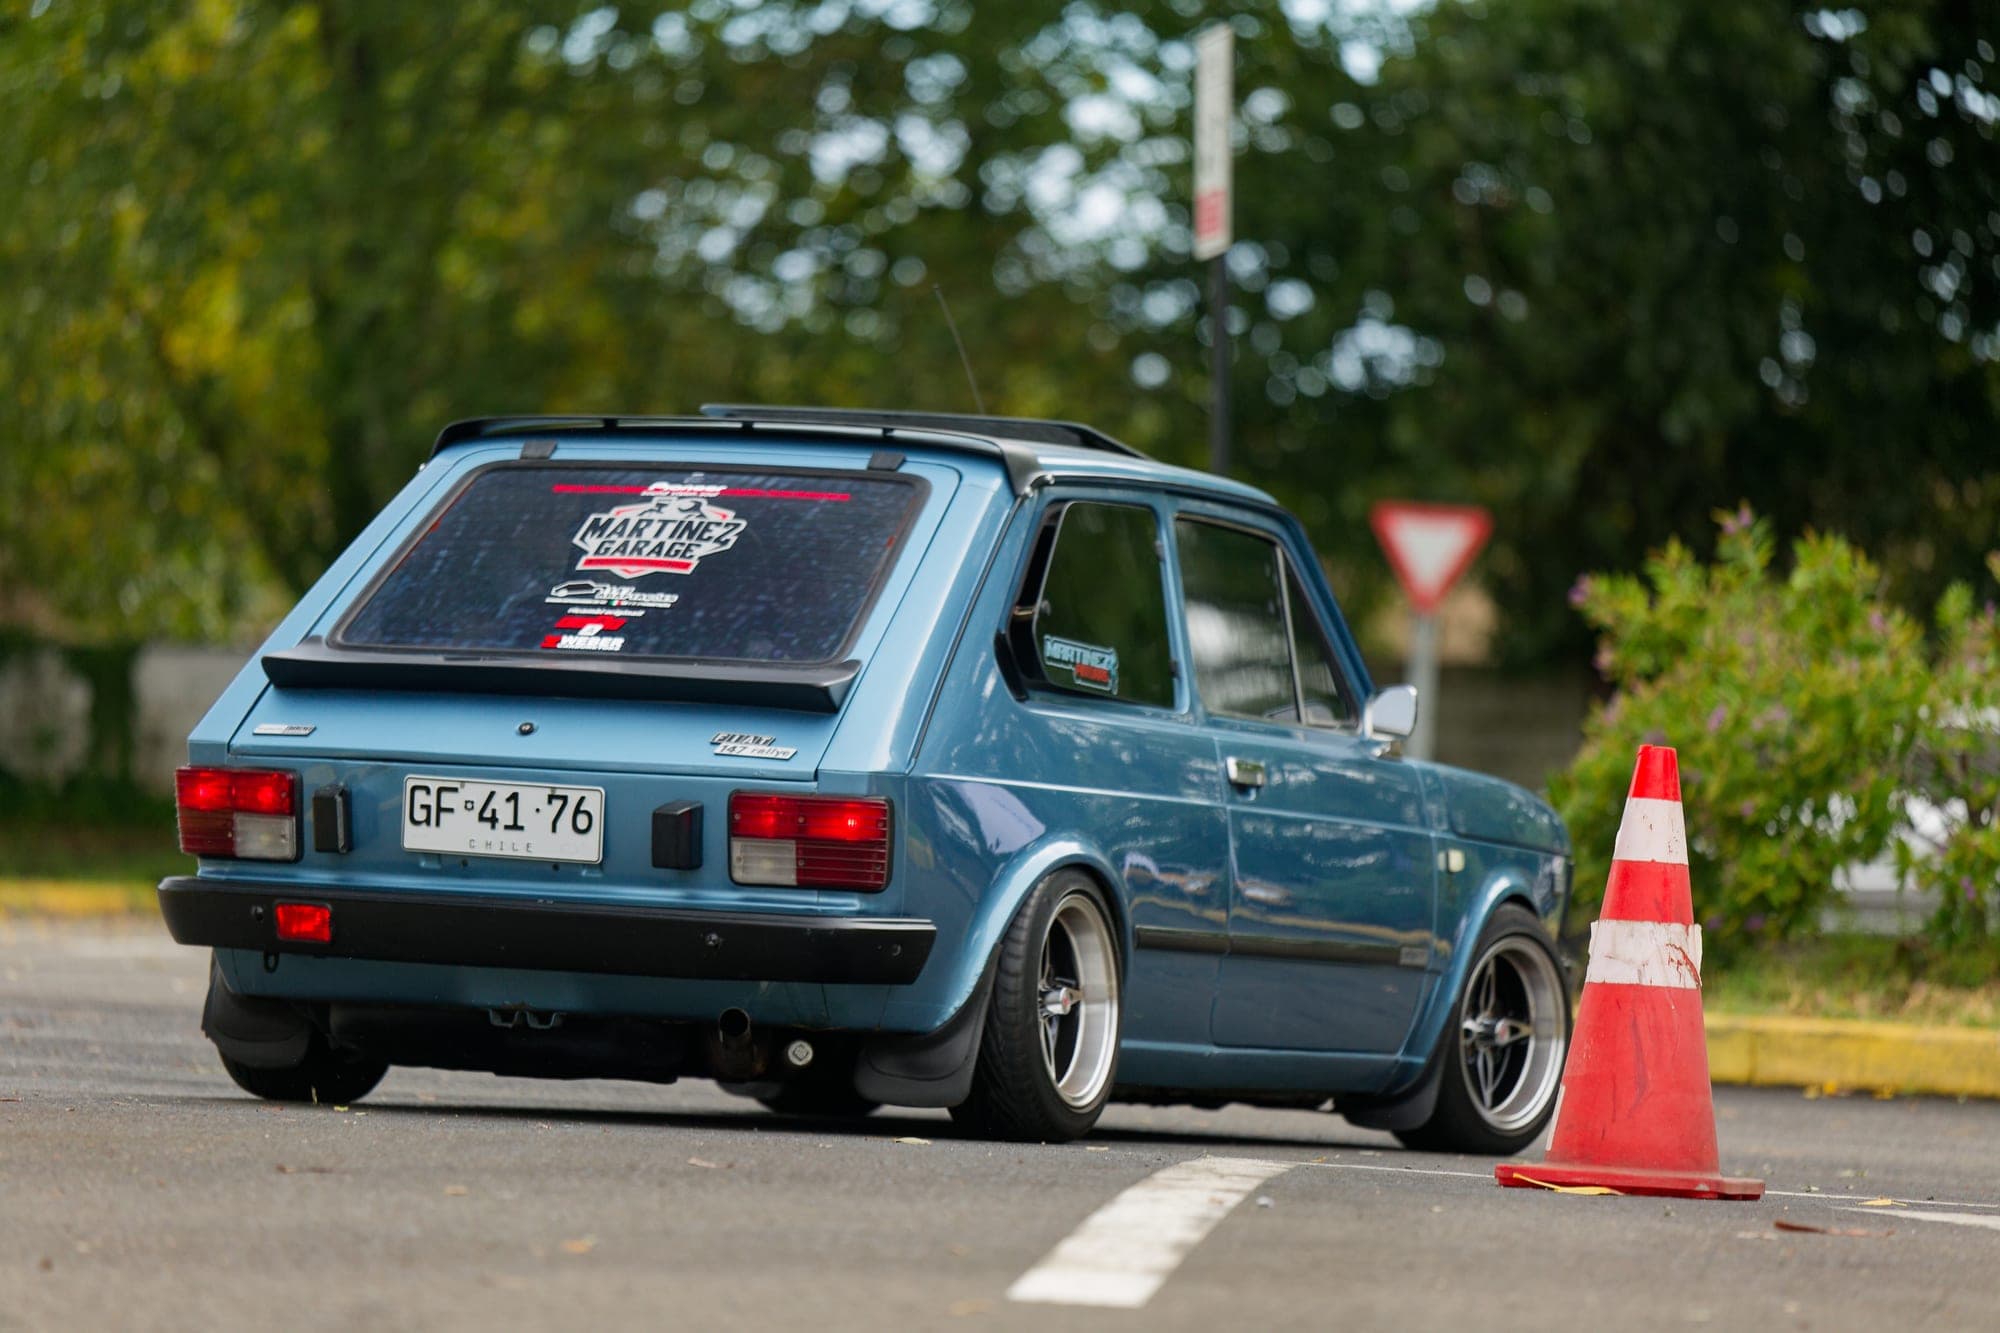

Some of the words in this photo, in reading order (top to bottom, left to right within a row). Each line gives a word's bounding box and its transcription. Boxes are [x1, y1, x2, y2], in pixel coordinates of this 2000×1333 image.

[593, 540, 702, 559] GARAGE
[720, 744, 747, 754] 147
[469, 839, 533, 853] CHILE
